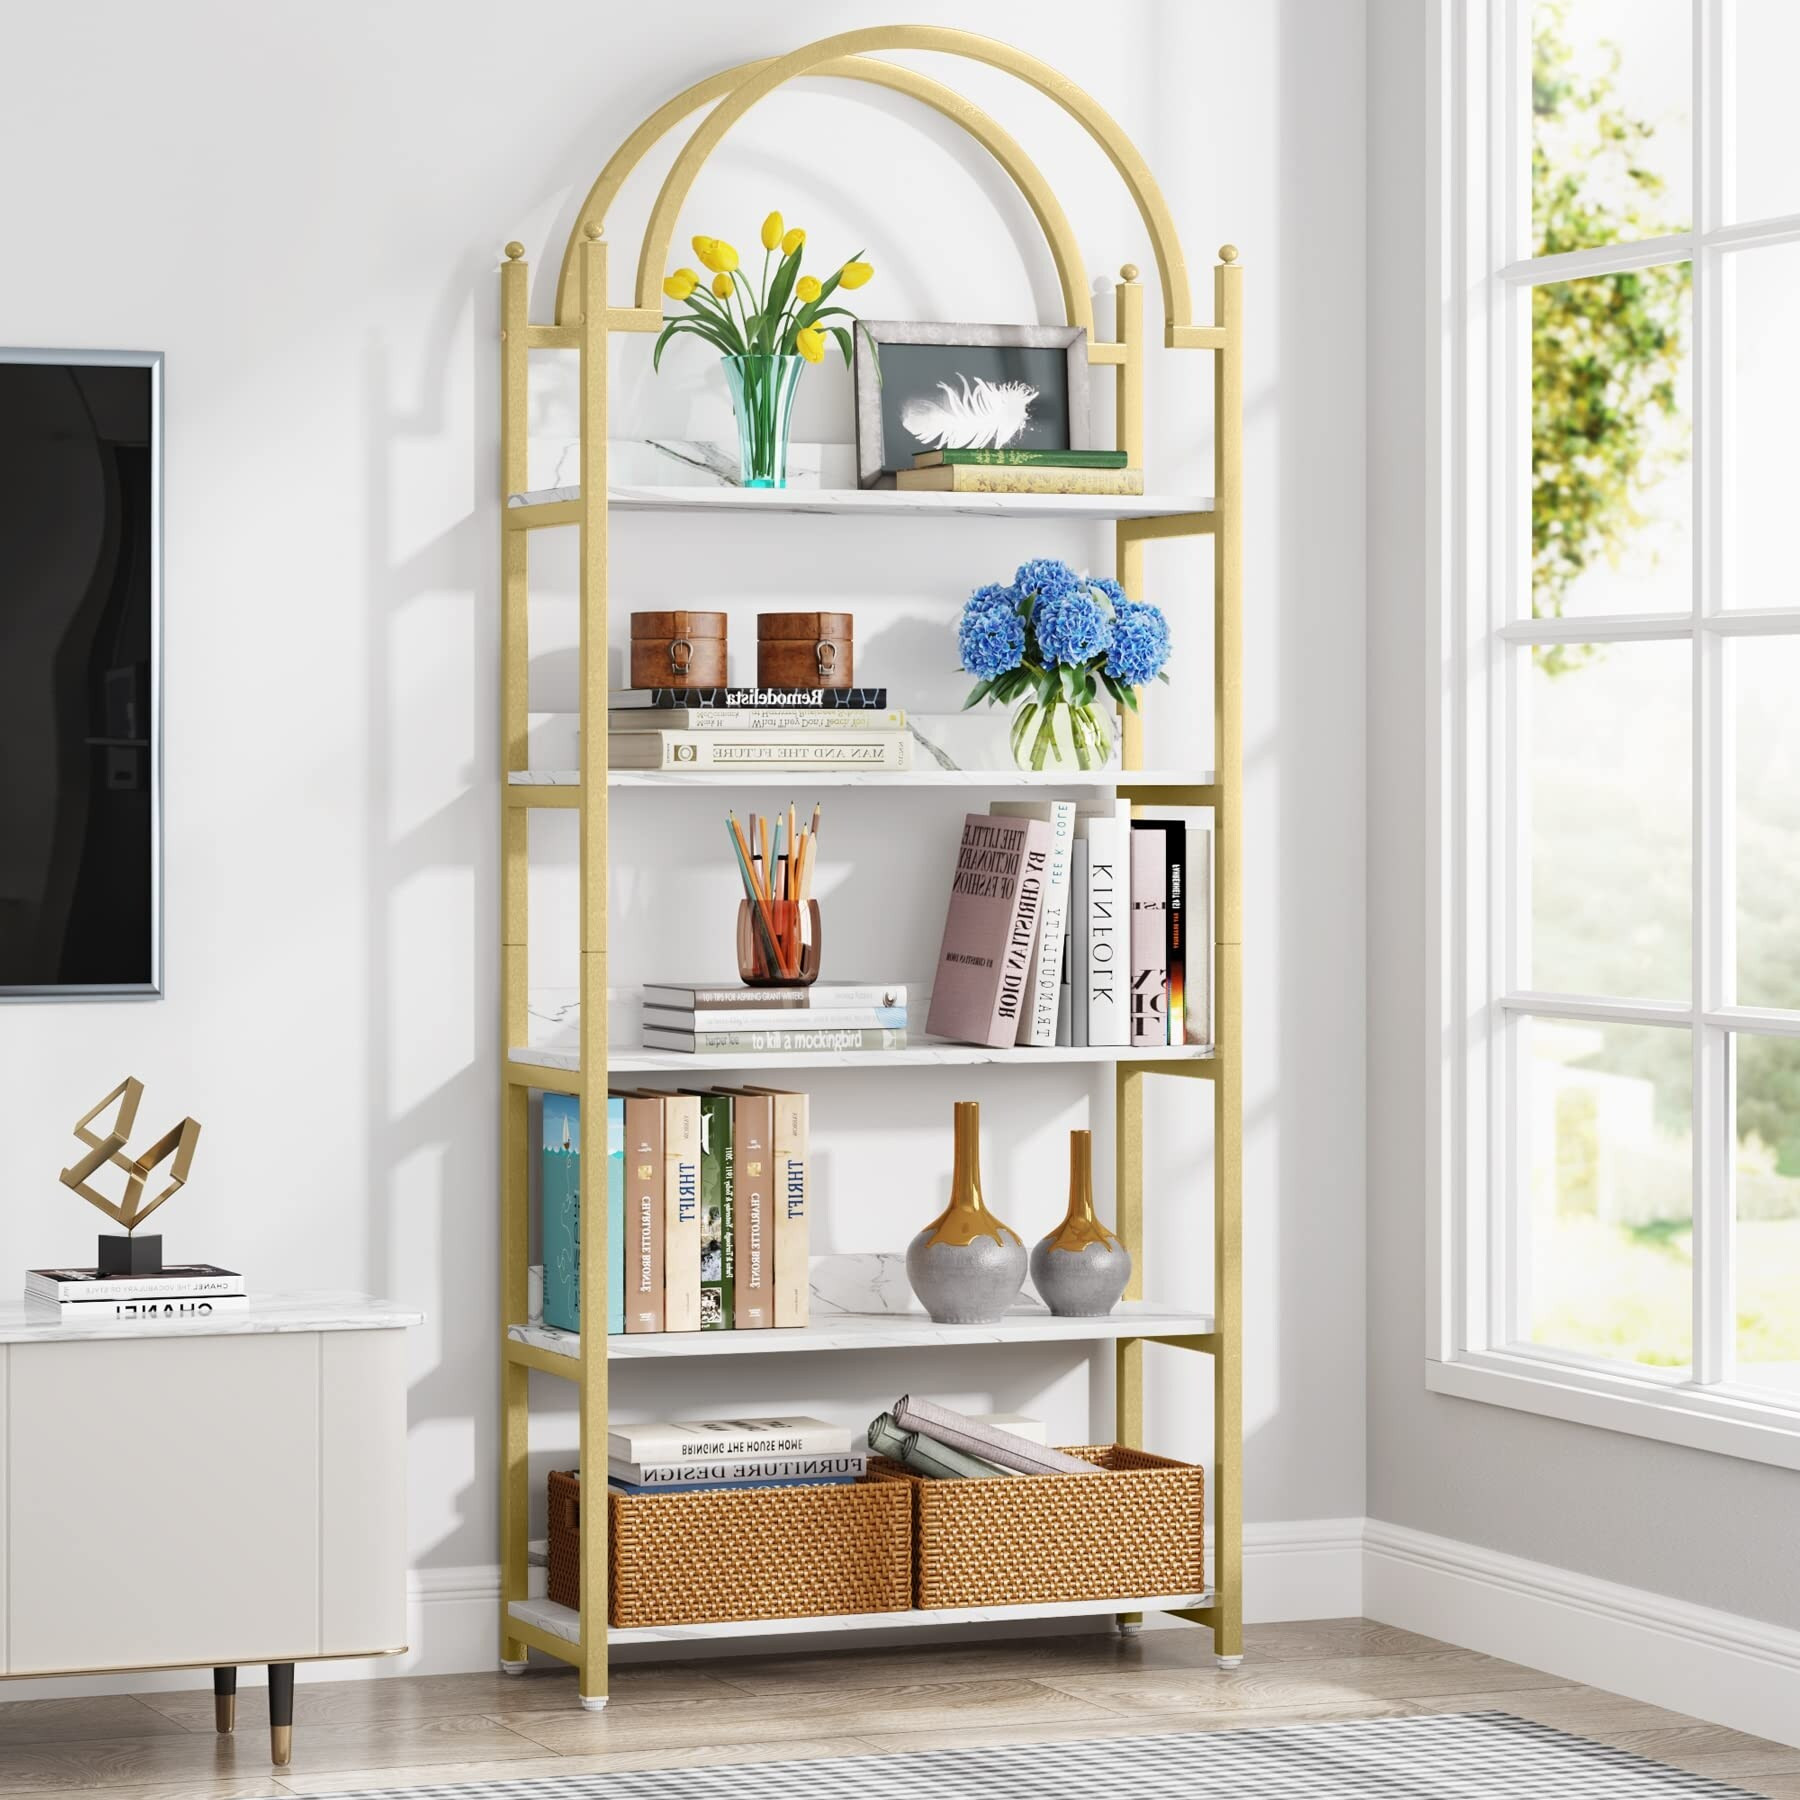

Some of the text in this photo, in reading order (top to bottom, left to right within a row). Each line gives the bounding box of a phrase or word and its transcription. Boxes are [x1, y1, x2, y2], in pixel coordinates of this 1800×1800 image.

[702, 991, 804, 1002] 101 TIPS FOR ASPIRING GRANT WRITERS
[705, 1034, 727, 1048] harper
[752, 1031, 862, 1051] to kill a mockingbird
